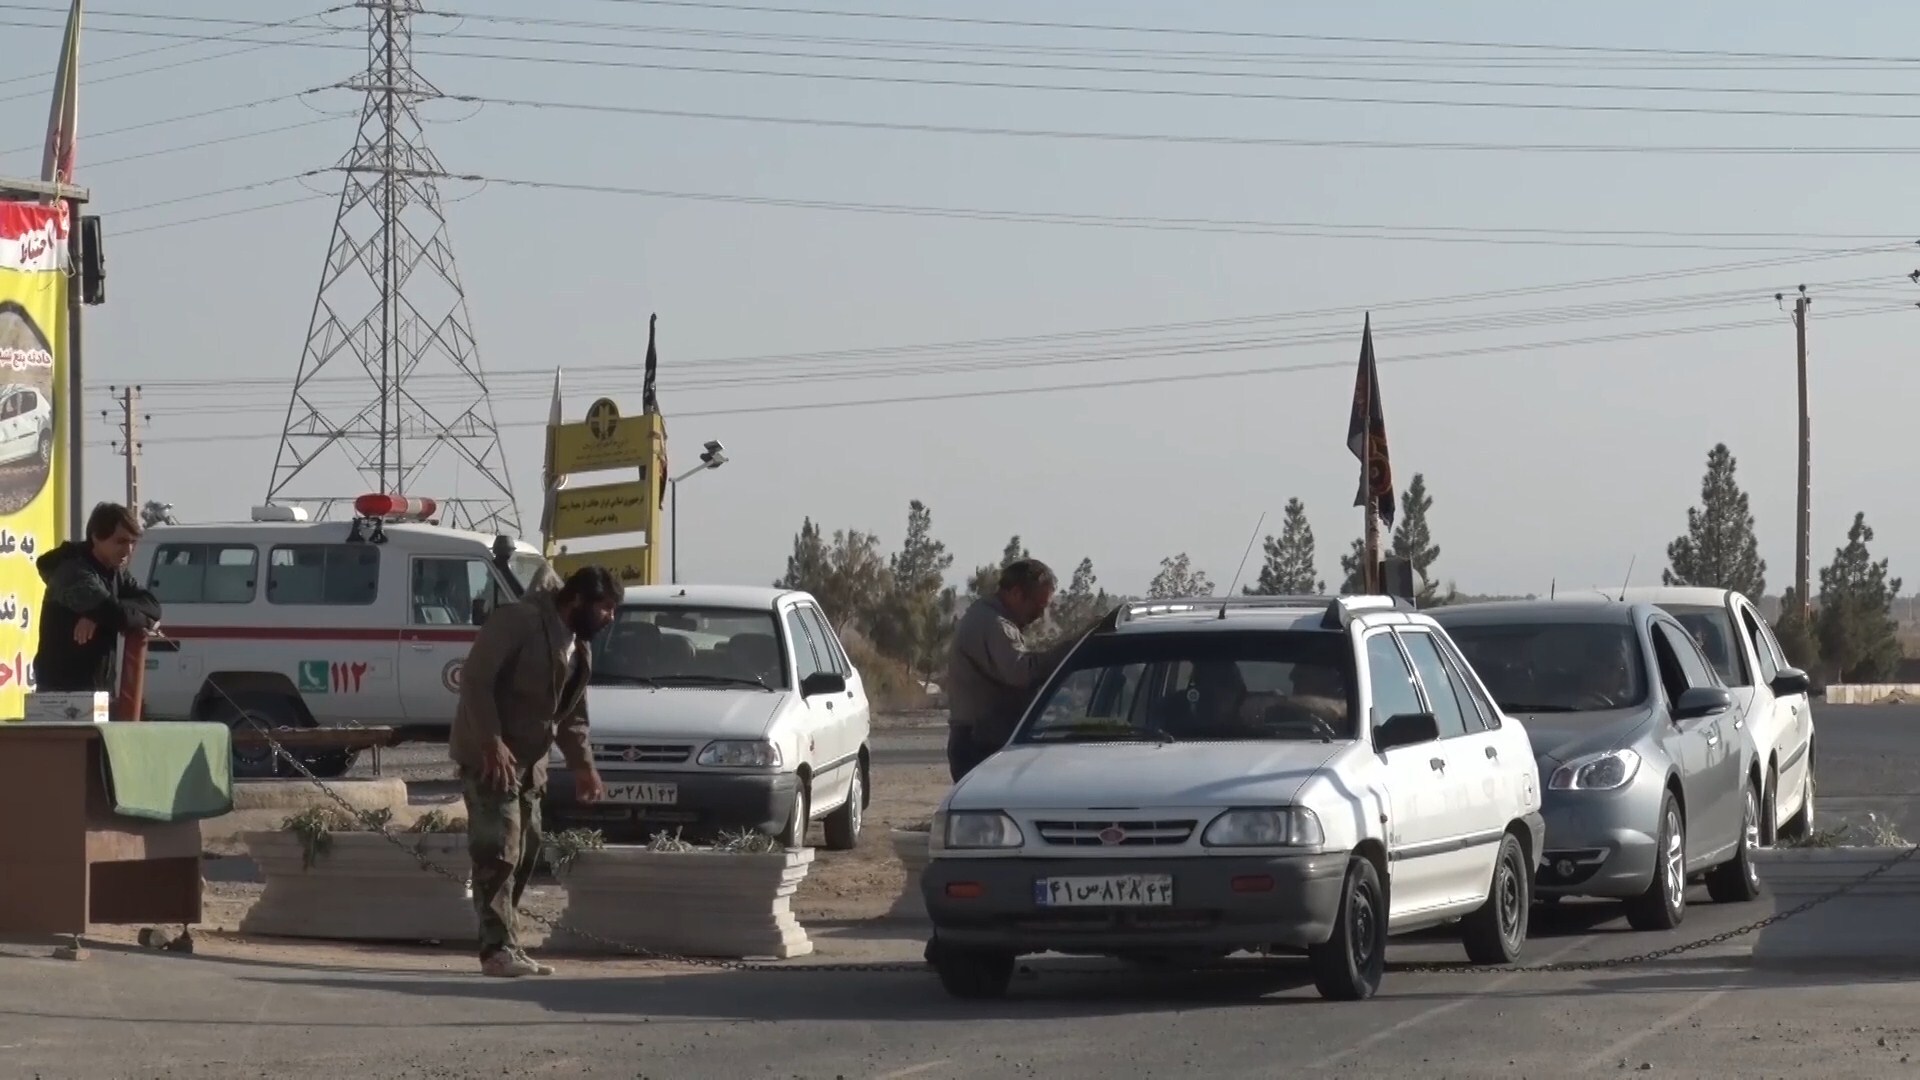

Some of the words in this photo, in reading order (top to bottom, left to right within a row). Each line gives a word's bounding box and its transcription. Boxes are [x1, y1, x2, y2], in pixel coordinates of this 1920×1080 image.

[19, 229, 55, 264] احتیاط
[0, 529, 16, 554] عل
[20, 535, 35, 560] به
[19, 607, 29, 629] و
[331, 661, 367, 693] ۱۱۲
